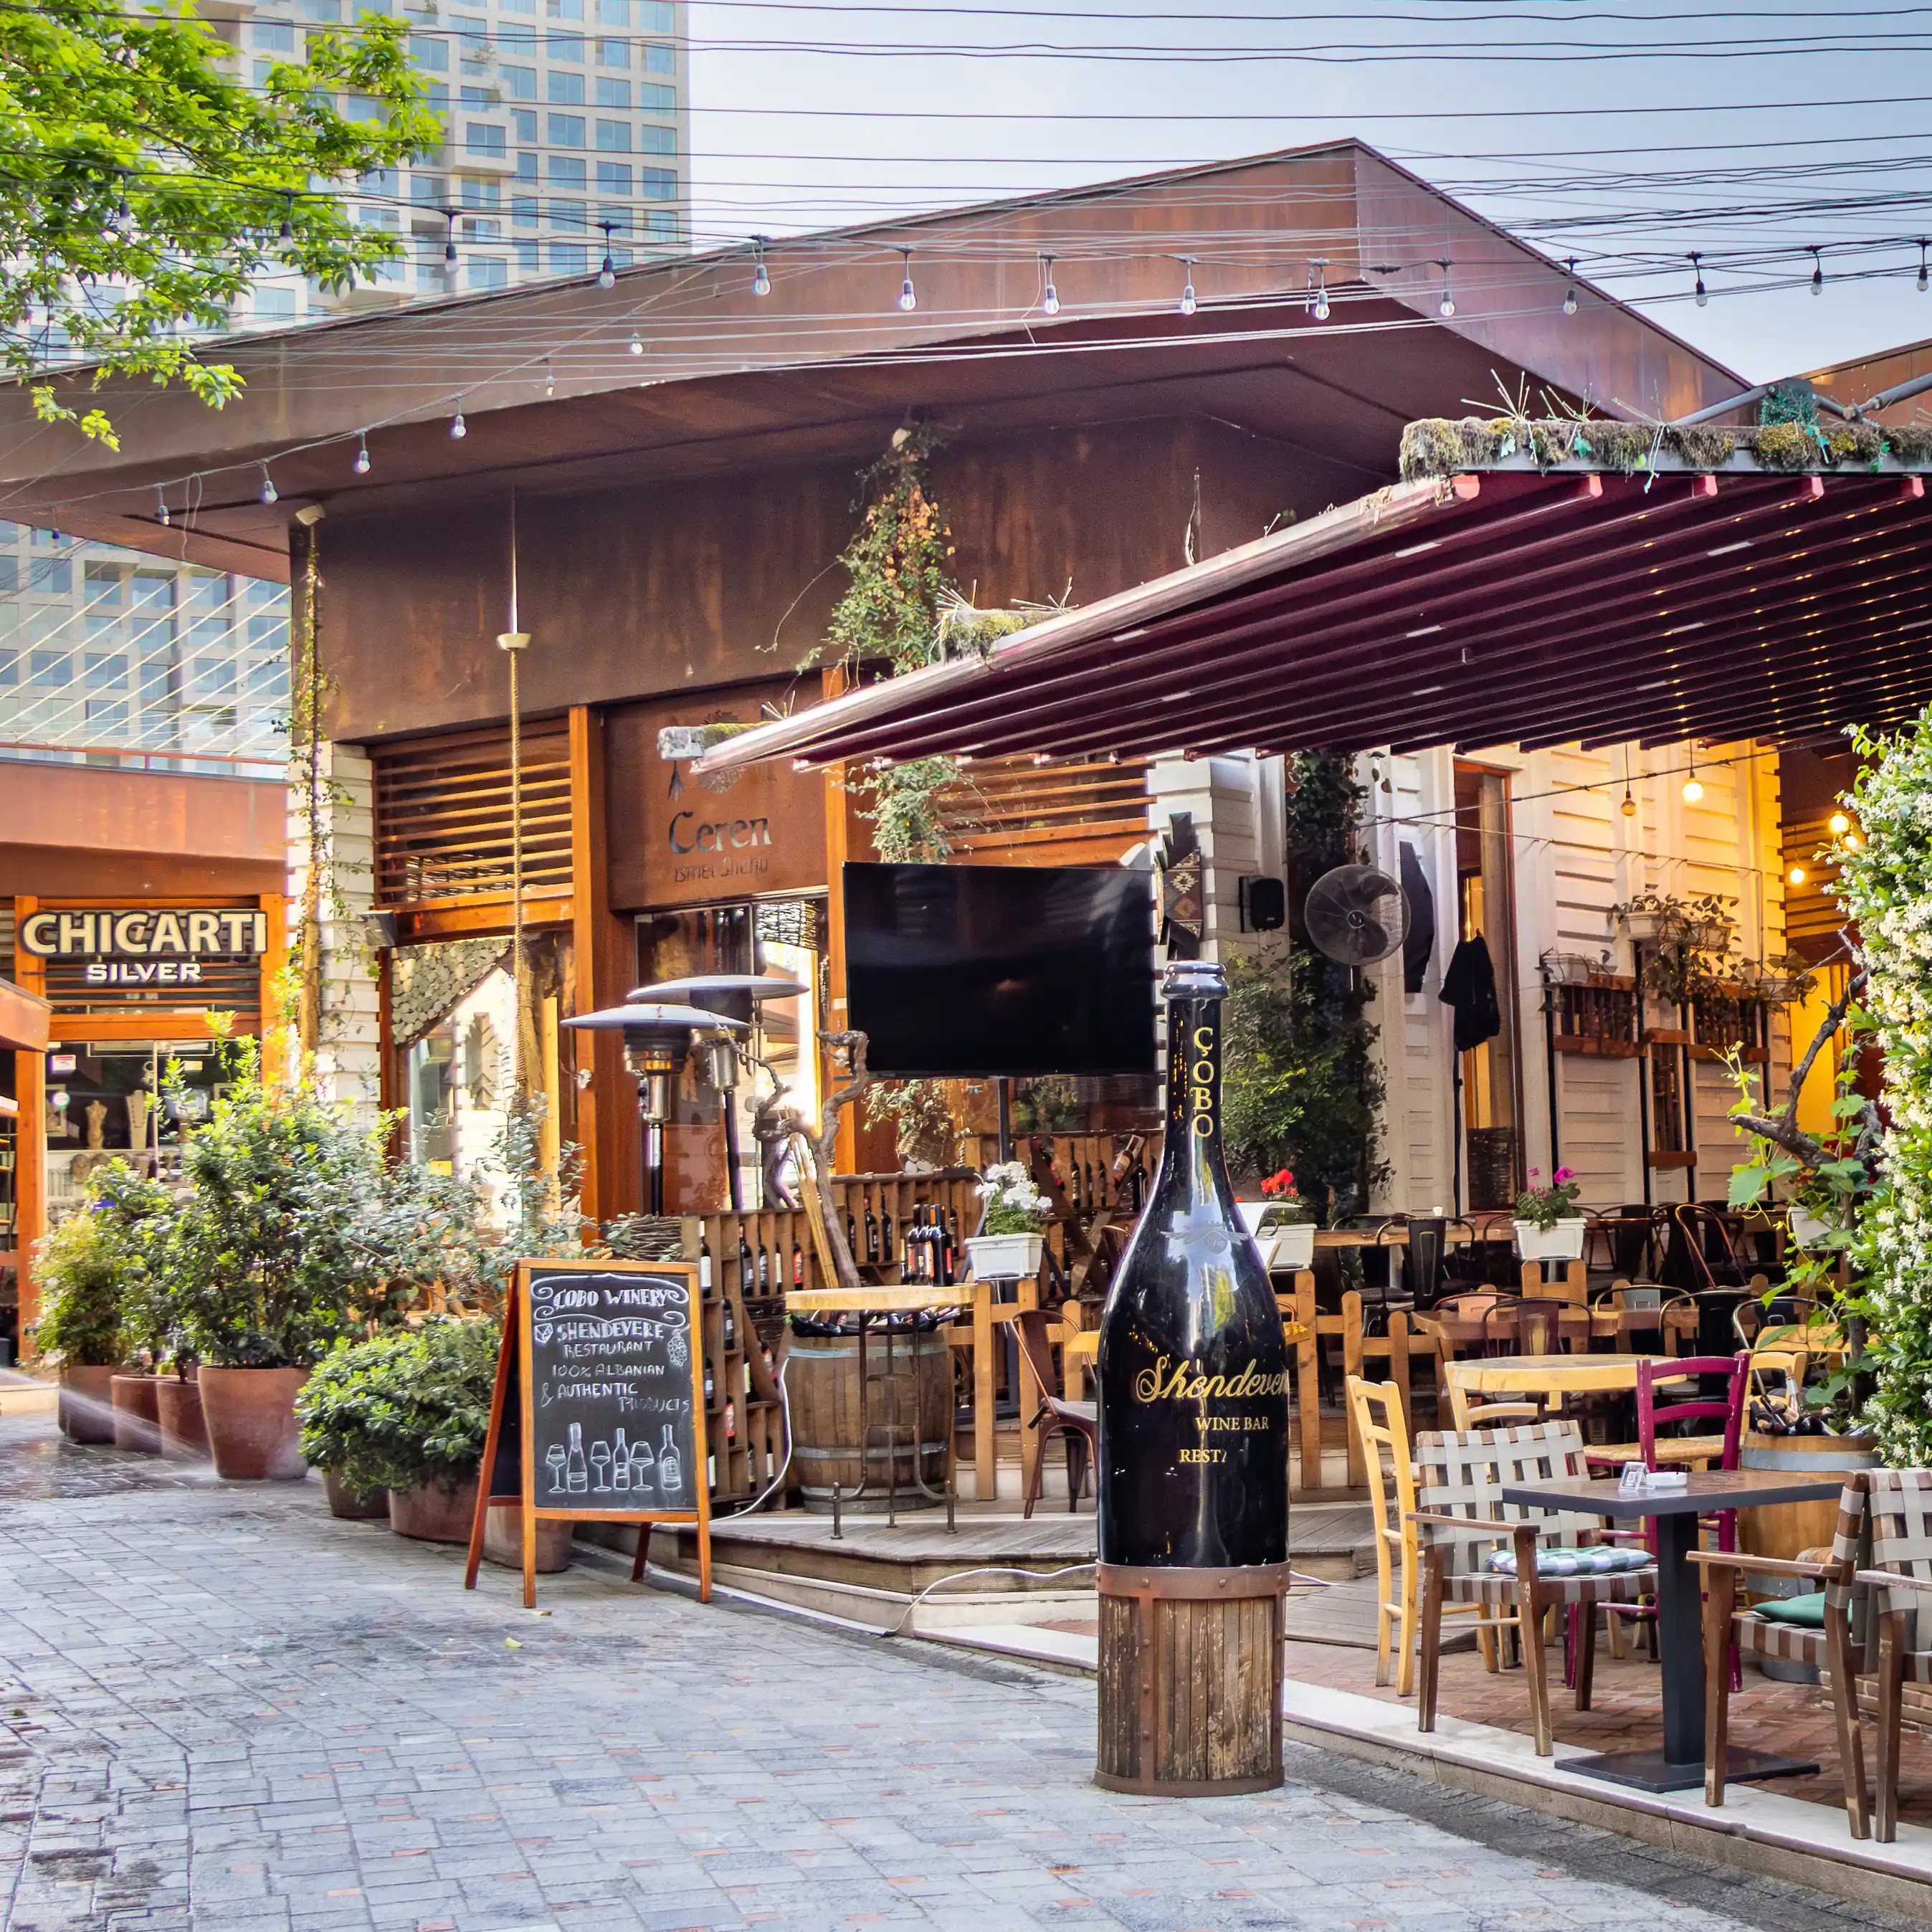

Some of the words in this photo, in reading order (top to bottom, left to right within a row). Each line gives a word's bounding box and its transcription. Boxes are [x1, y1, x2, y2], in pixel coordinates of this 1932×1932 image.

[669, 811, 773, 855] Ceren
[22, 912, 267, 954] CHICARTI
[86, 963, 203, 981] SILVER
[1191, 1027, 1214, 1138] ÇOBO
[604, 1289, 670, 1307] WINERY
[556, 1320, 665, 1342] SHENDEVERE
[563, 1341, 654, 1358] RESTAURANT
[552, 1364, 591, 1378] 100%
[594, 1364, 665, 1376] ALBANIAN
[541, 1382, 554, 1407] &
[557, 1382, 639, 1399] AUTHENTIC
[1195, 1417, 1240, 1431] WINE
[1243, 1416, 1269, 1430] BAR
